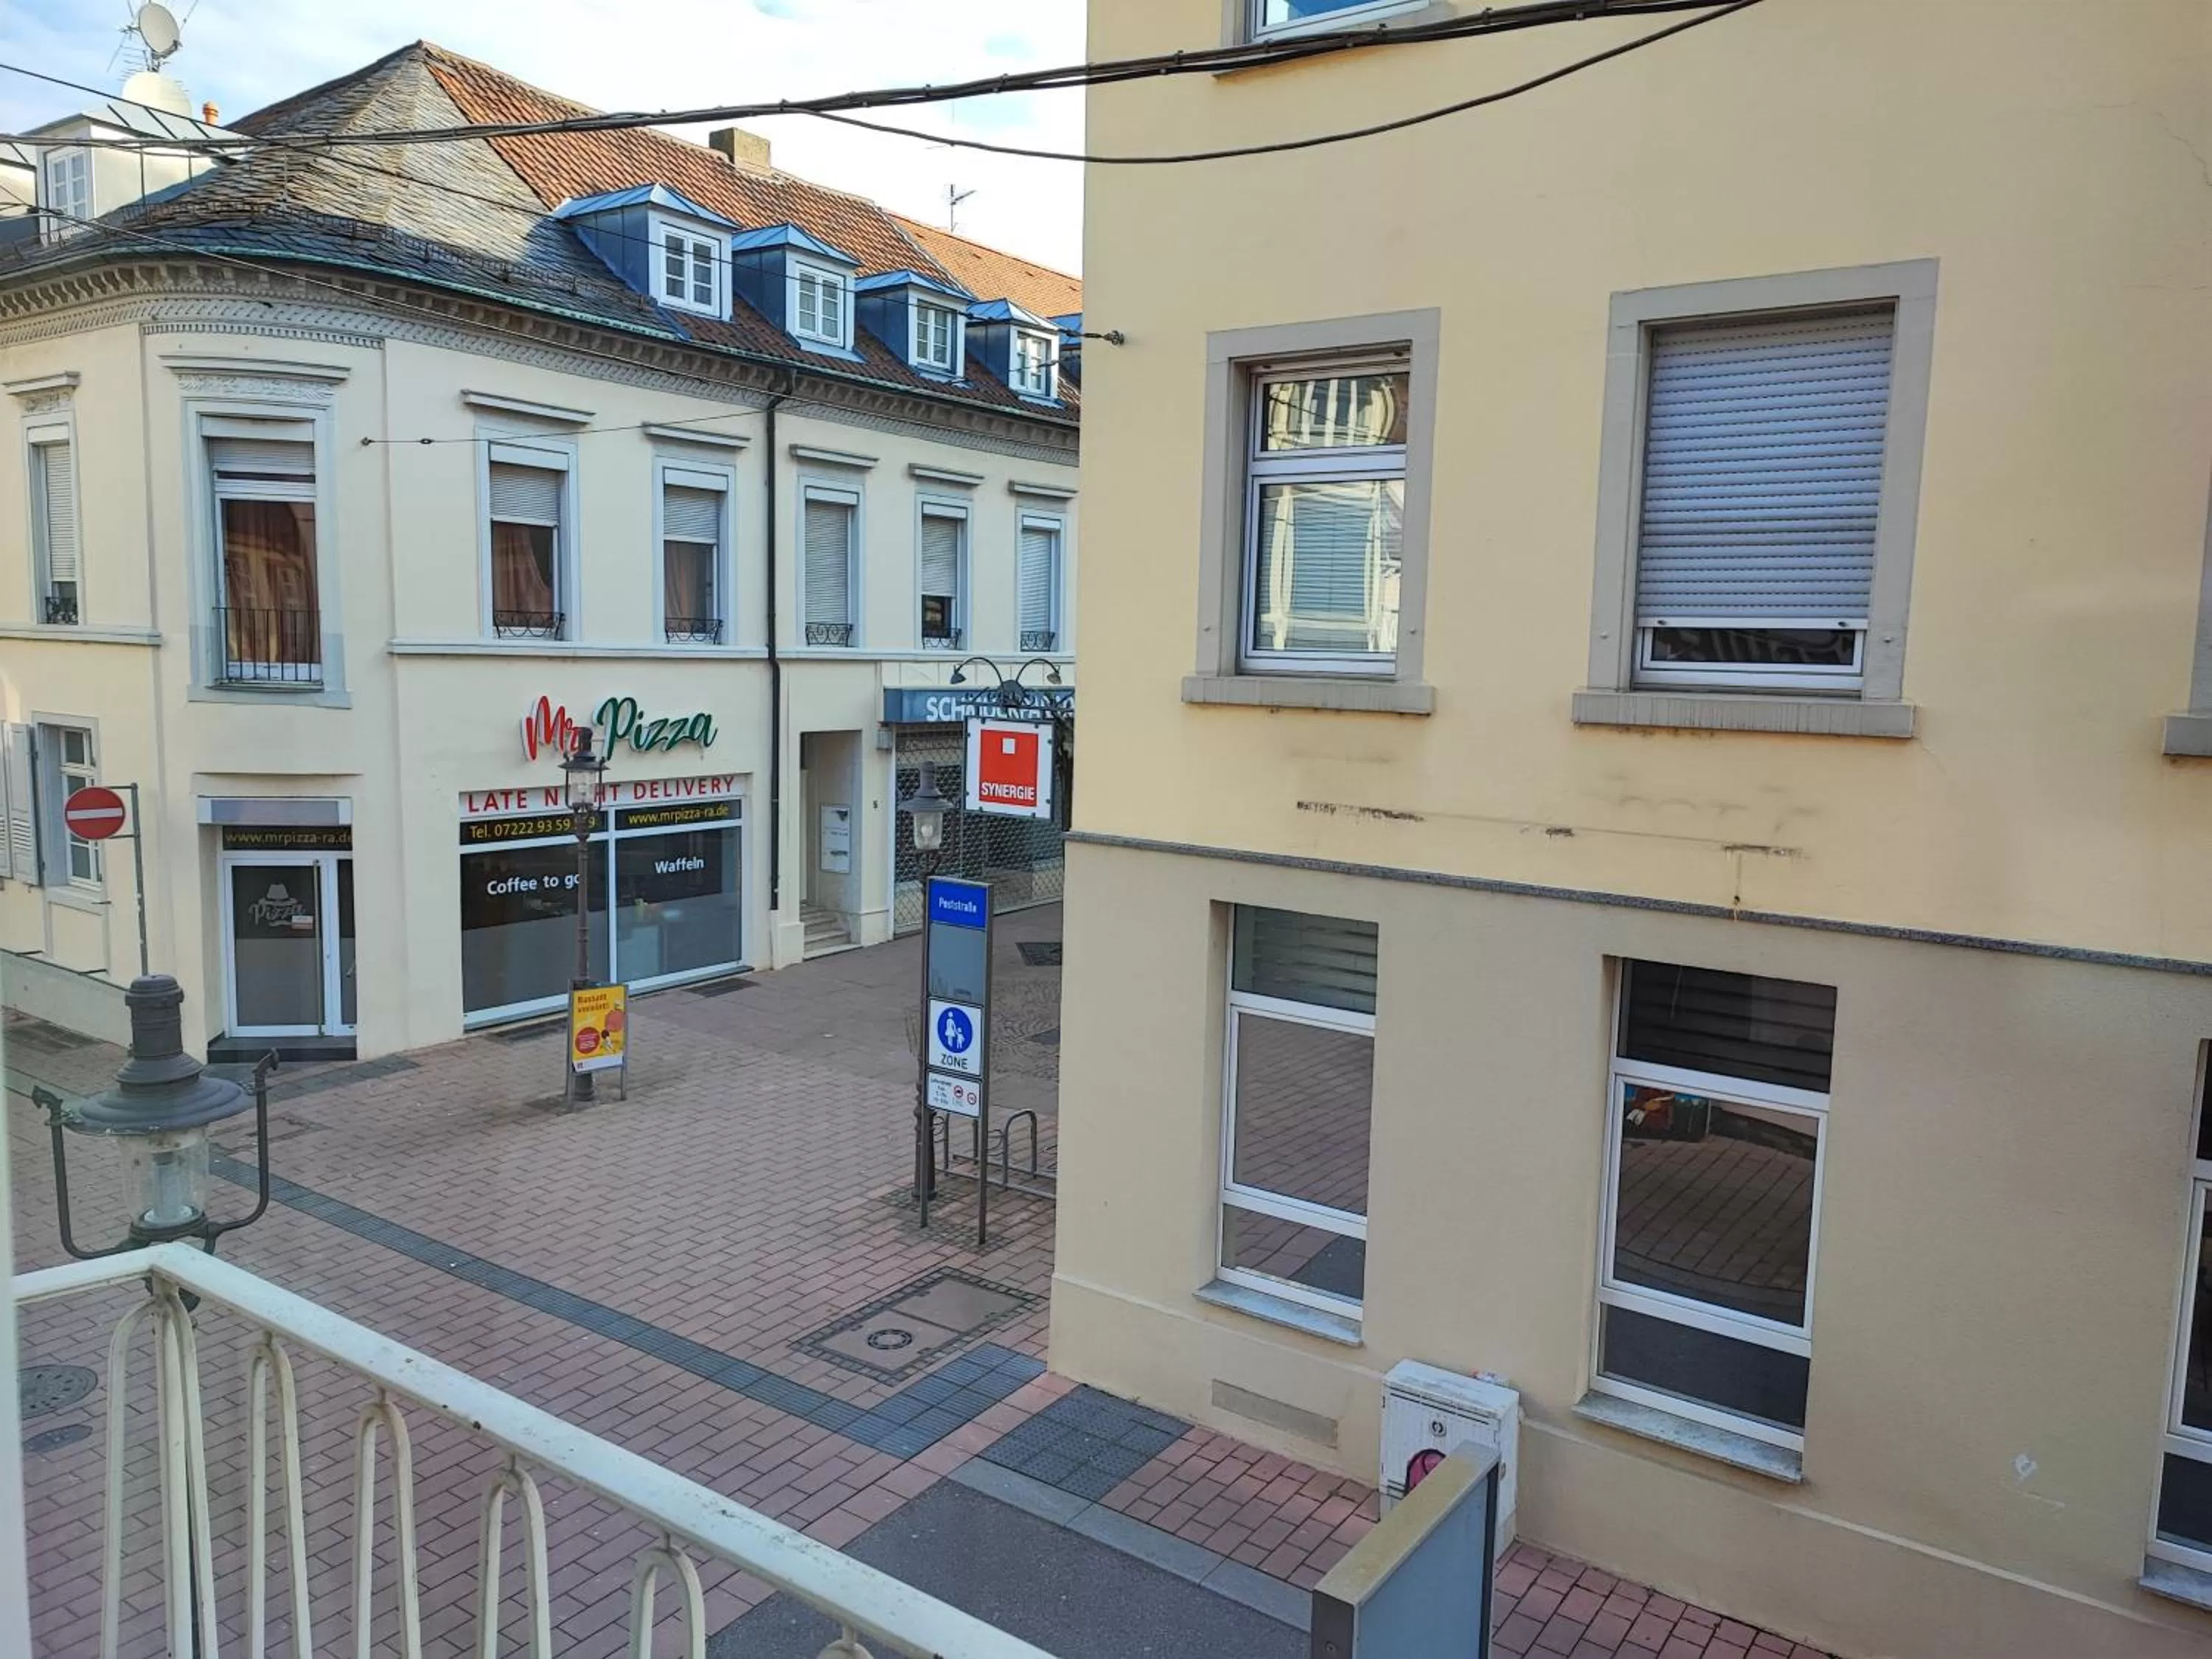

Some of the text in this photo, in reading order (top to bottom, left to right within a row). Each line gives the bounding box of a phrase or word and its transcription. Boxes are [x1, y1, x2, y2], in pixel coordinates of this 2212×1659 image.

[526, 695, 718, 760] Mr Pizza
[468, 776, 736, 813] LATE NHT DELIVERY
[981, 782, 1034, 800] SYNERGIE
[628, 804, 730, 824] www.mrpizza-ra.de
[469, 825, 491, 838] Tel.
[495, 822, 534, 838] 07222
[537, 820, 552, 832] 93
[556, 818, 570, 831] 59
[655, 857, 704, 874] Waffeln
[487, 878, 538, 895] Coffee
[543, 874, 559, 888] to
[940, 1053, 968, 1070] ZONE
